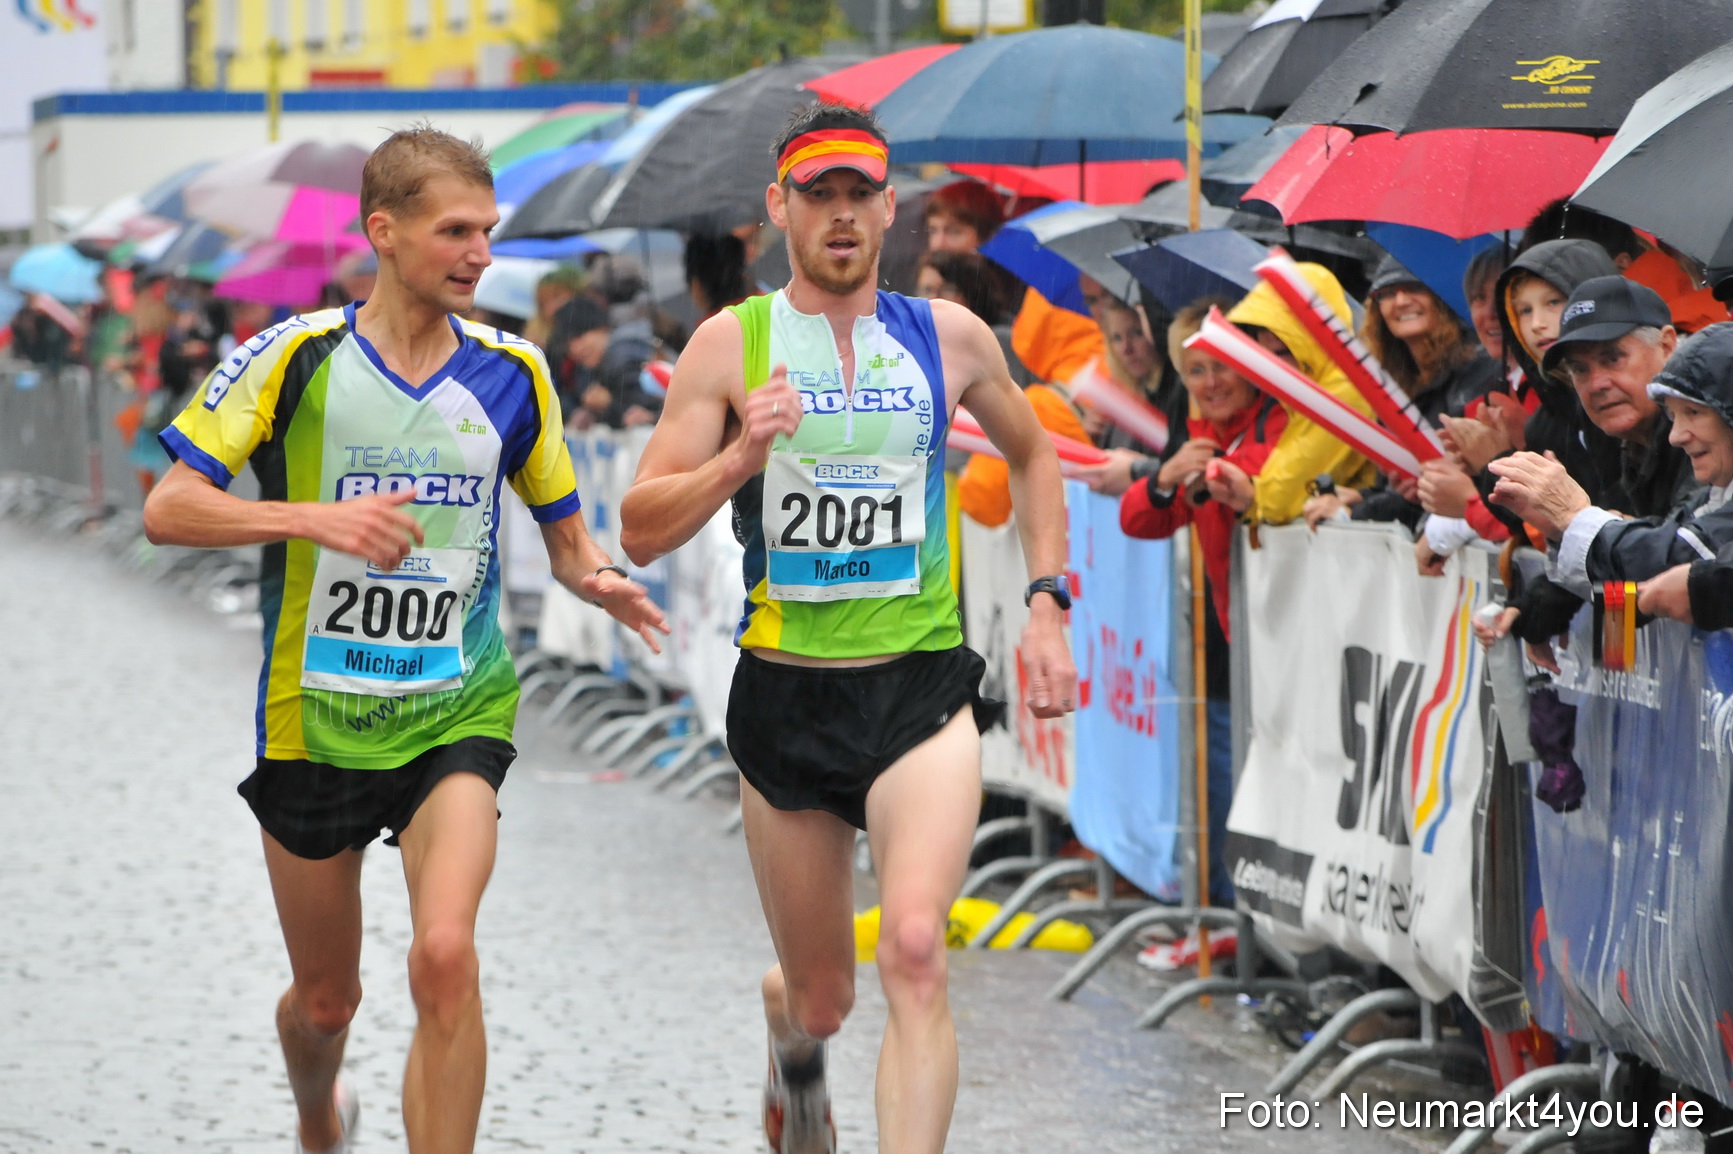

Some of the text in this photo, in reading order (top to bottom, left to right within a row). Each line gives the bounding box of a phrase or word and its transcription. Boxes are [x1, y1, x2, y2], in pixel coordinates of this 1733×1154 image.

[799, 386, 916, 415] BOCK
[345, 446, 438, 468] TEAM
[815, 464, 879, 480] BOCK
[335, 472, 485, 507] BOCK
[781, 492, 903, 549] 2001
[771, 539, 777, 549] A
[814, 559, 870, 581] Marco
[325, 580, 458, 642] 2000
[312, 625, 320, 635] A
[344, 648, 424, 676] Michael
